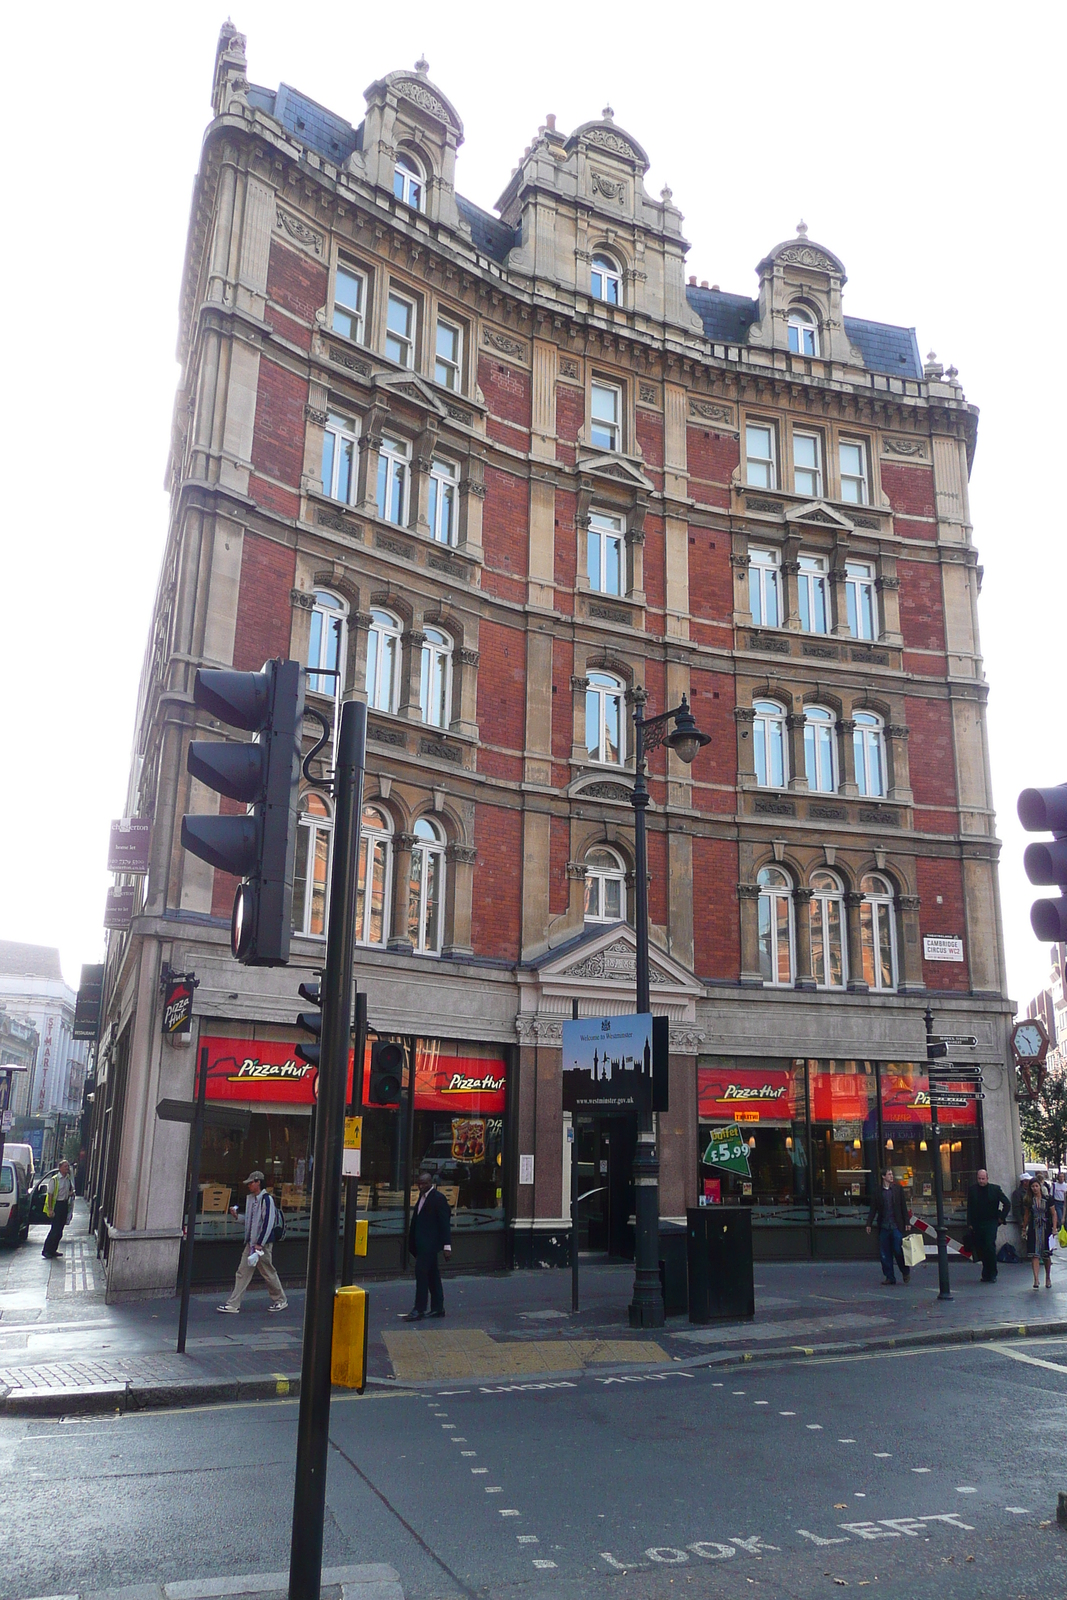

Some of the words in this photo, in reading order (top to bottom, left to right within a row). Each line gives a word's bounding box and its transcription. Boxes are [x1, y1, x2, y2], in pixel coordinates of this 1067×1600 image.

[111, 823, 149, 831] cherton
[927, 946, 947, 954] CIRCUS
[164, 998, 190, 1024] Pizza
[168, 1007, 187, 1028] Hut
[606, 1032, 633, 1040] Westminster
[238, 1060, 280, 1077] Pizza
[280, 1060, 313, 1077] Hut
[448, 1074, 481, 1090] Pizza
[481, 1074, 507, 1089] Hut
[724, 1085, 758, 1099] Pizza
[758, 1085, 787, 1097] Hut
[576, 1096, 634, 1106] www.westminster.gov.uk
[711, 1128, 739, 1140] buffet
[711, 1143, 749, 1163] £5.99
[595, 1371, 695, 1385] LOOK
[478, 1381, 578, 1394] RIGHT
[600, 1535, 782, 1569] LOOK
[797, 1513, 974, 1546] LEFT
